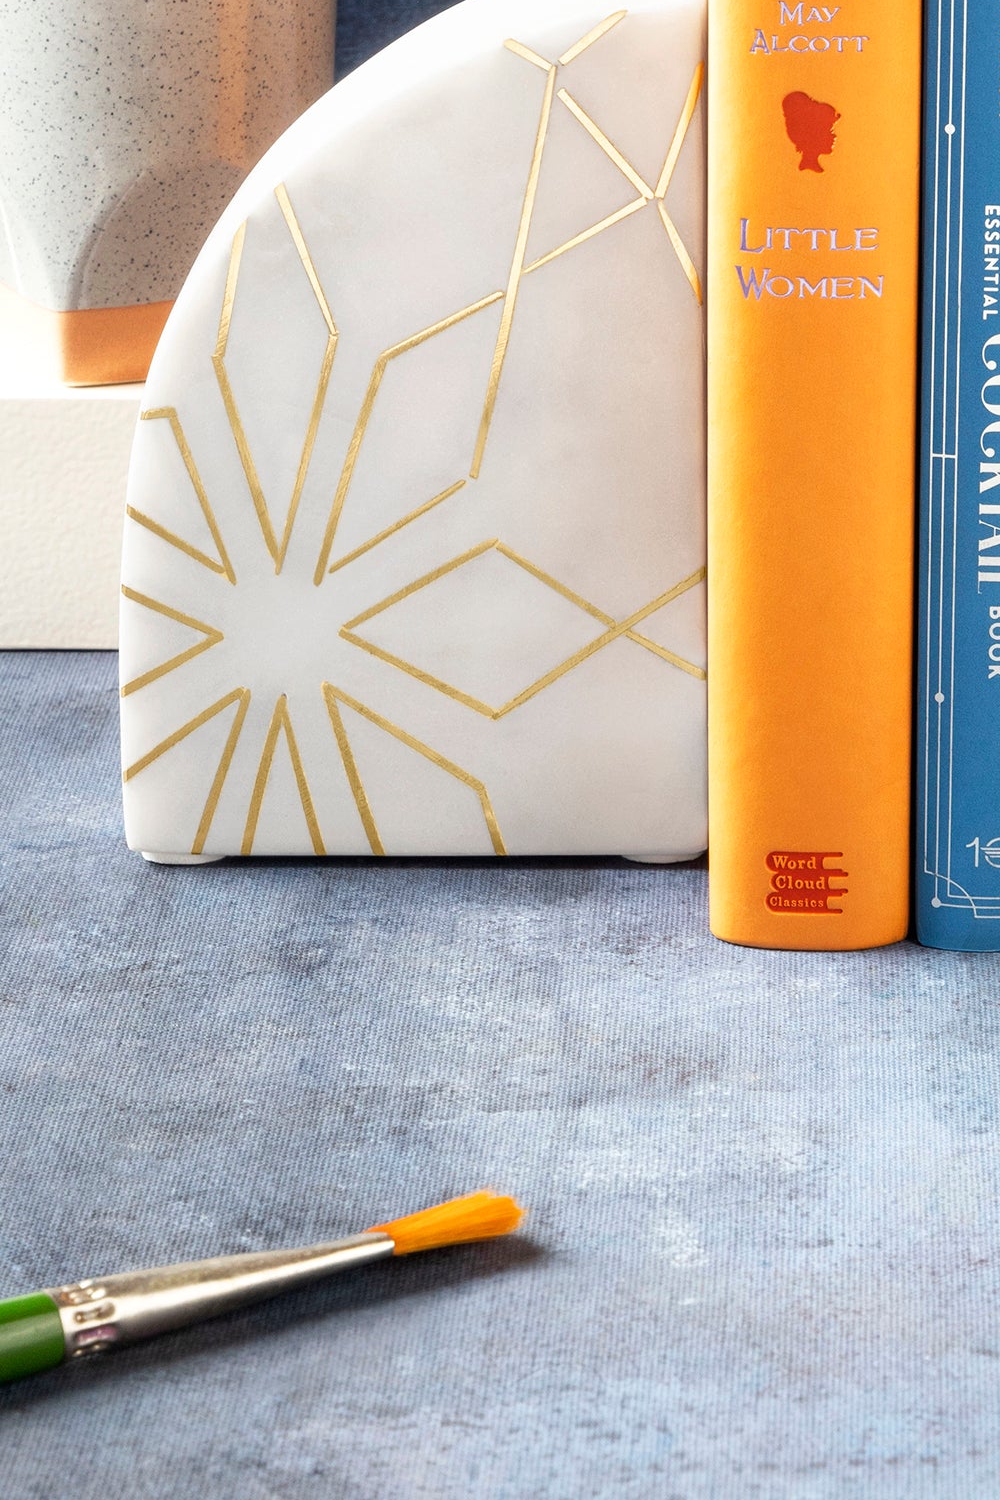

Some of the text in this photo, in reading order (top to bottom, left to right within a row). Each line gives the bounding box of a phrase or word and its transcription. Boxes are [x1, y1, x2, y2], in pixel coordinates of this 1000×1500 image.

[779, 0, 841, 26] MAY
[749, 29, 870, 55] ALCOTT
[739, 218, 880, 253] LITTLE
[982, 204, 1000, 321] ESSENTIAL
[735, 265, 884, 301] WOMEN
[772, 855, 817, 869] Word
[775, 875, 826, 890] Cloud
[769, 896, 824, 908] Classics
